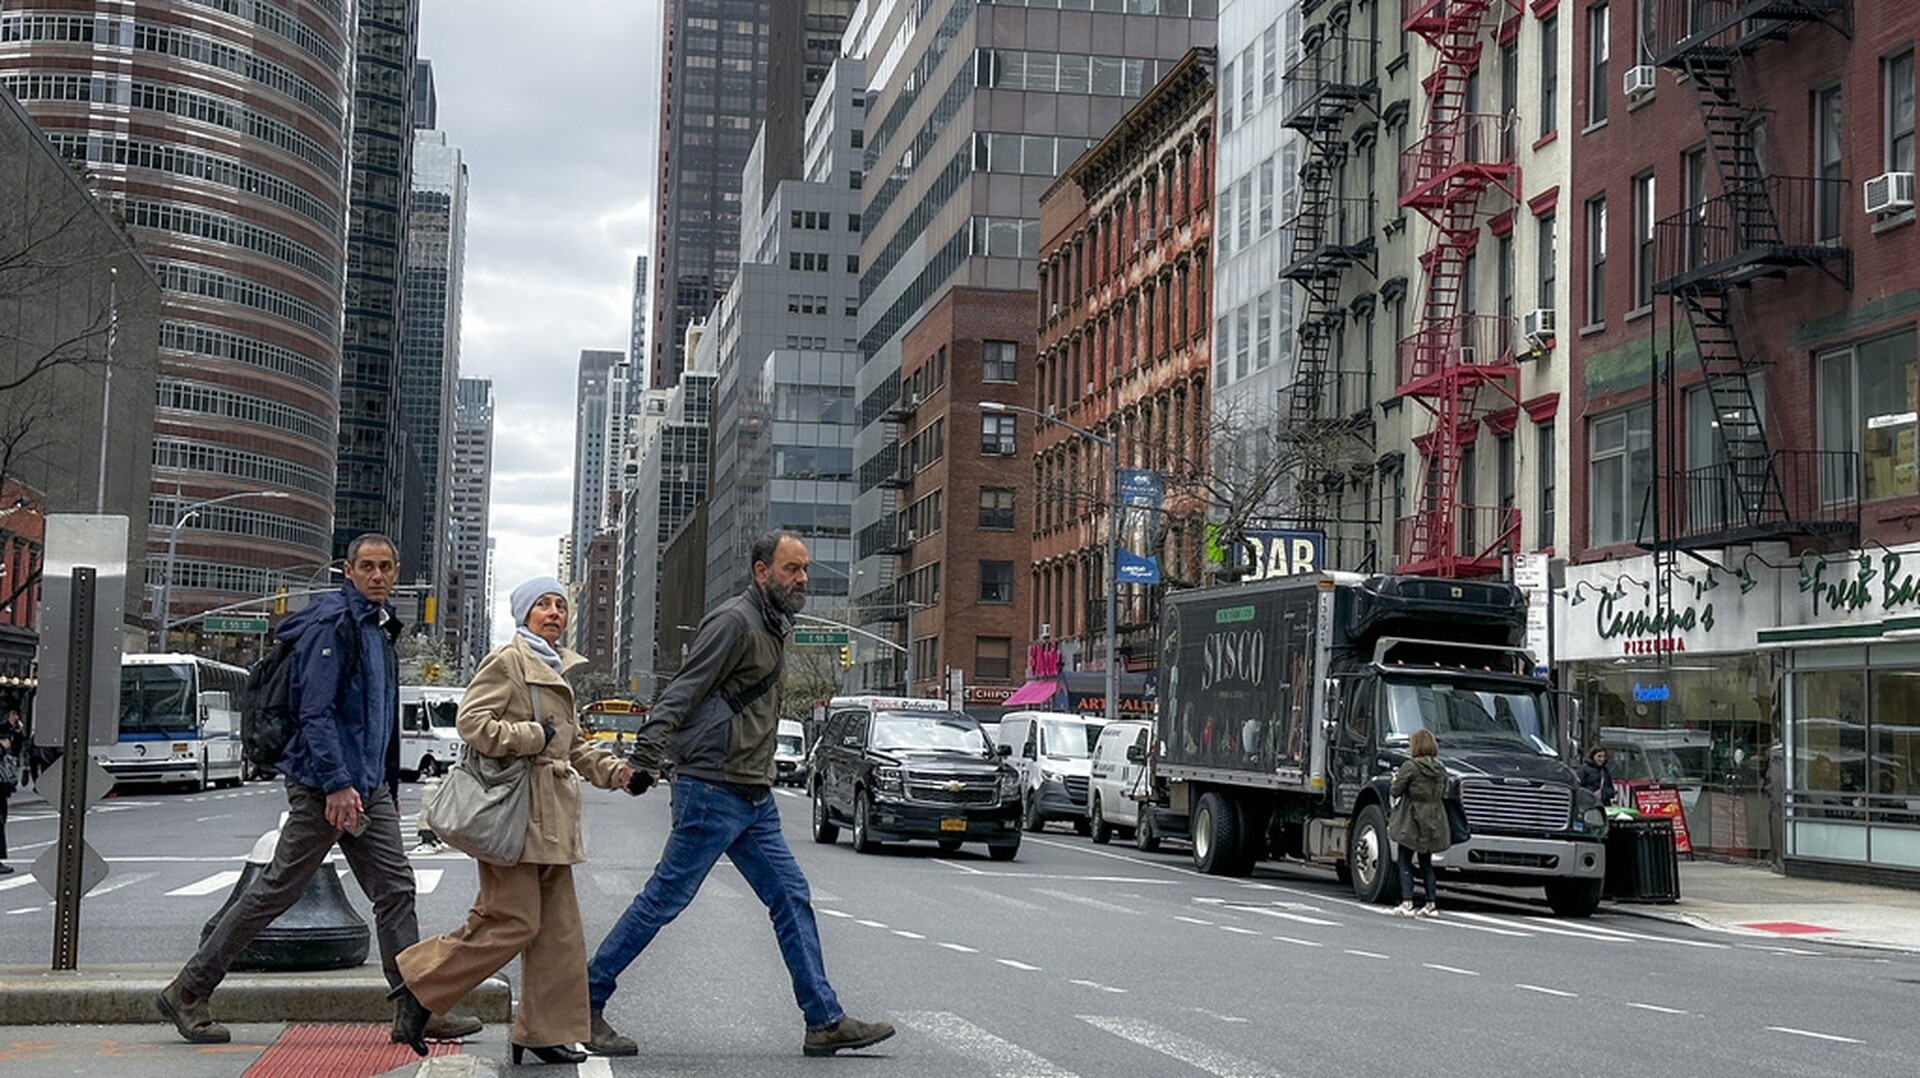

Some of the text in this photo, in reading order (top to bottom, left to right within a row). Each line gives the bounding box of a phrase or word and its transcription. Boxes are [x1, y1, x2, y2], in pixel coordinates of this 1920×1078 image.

[1241, 537, 1314, 582] BAR
[1813, 555, 1872, 616] Fresh
[1201, 629, 1264, 691] SYSCO
